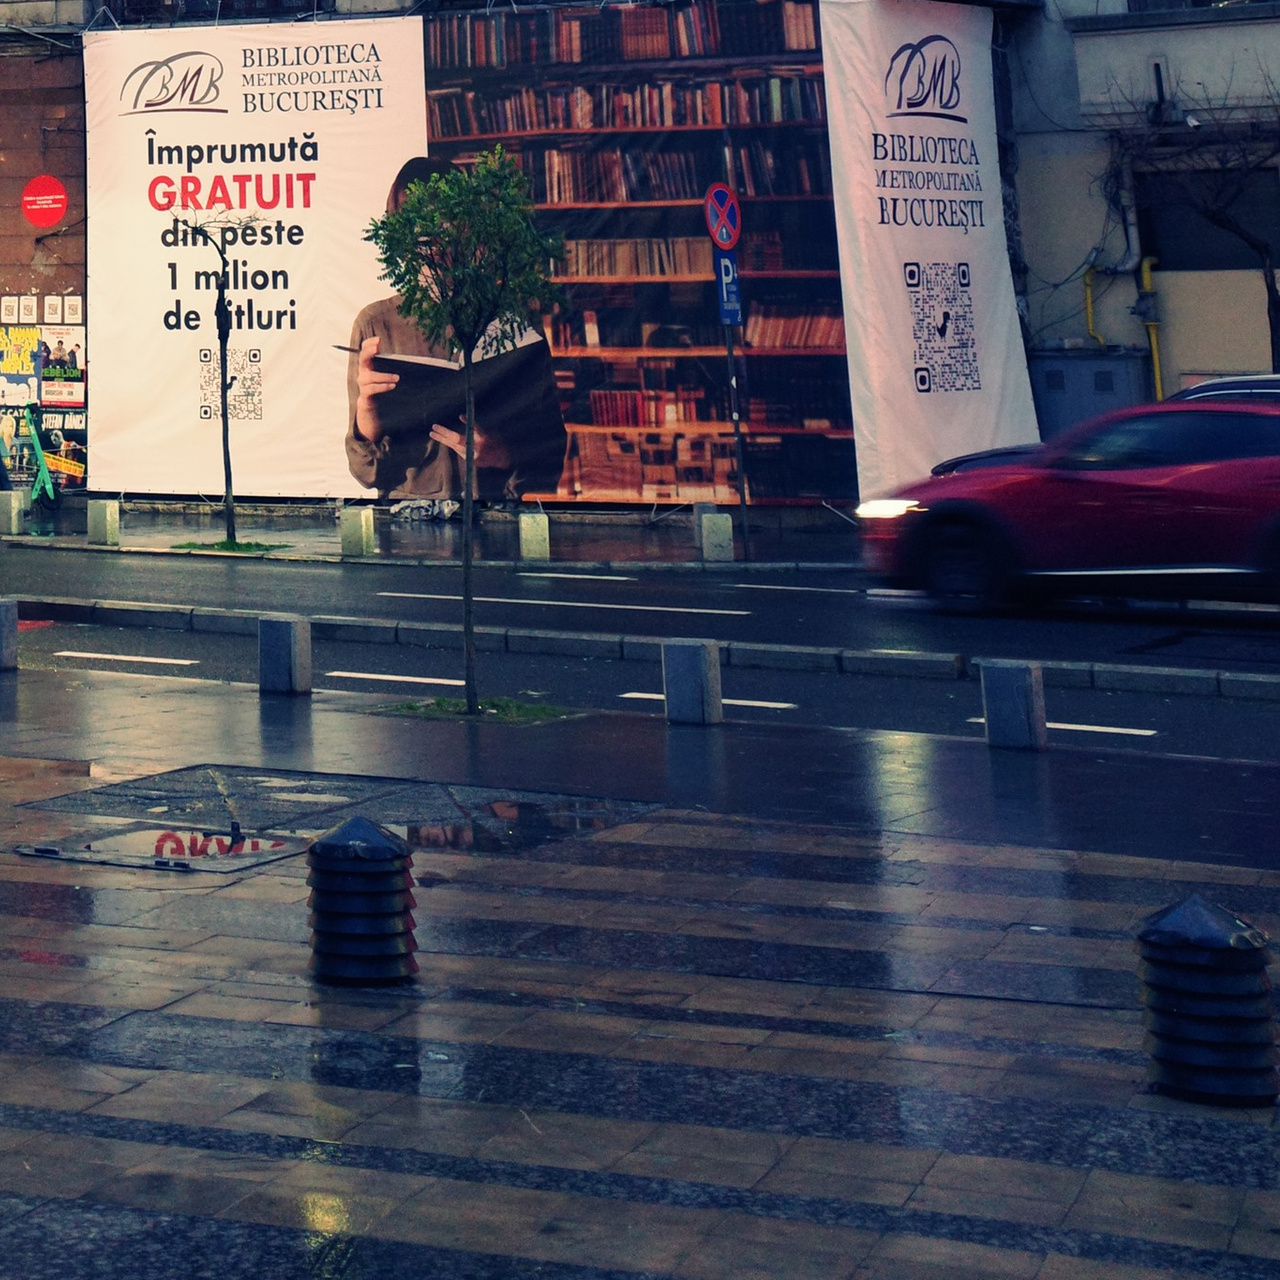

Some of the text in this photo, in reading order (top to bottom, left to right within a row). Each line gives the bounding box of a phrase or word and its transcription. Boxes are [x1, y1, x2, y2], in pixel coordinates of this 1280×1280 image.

[241, 43, 382, 68] BIBLIOTECA
[241, 65, 382, 87] METROPOLITANĂ
[145, 128, 319, 173] Împrumută
[872, 133, 980, 165] BIBLIOTECA
[148, 173, 316, 212] GRATUIT
[875, 169, 983, 191] METROPOLITANĂ
[161, 218, 305, 255] din peste
[168, 259, 288, 290] 1 milion
[163, 299, 297, 330] de itluri
